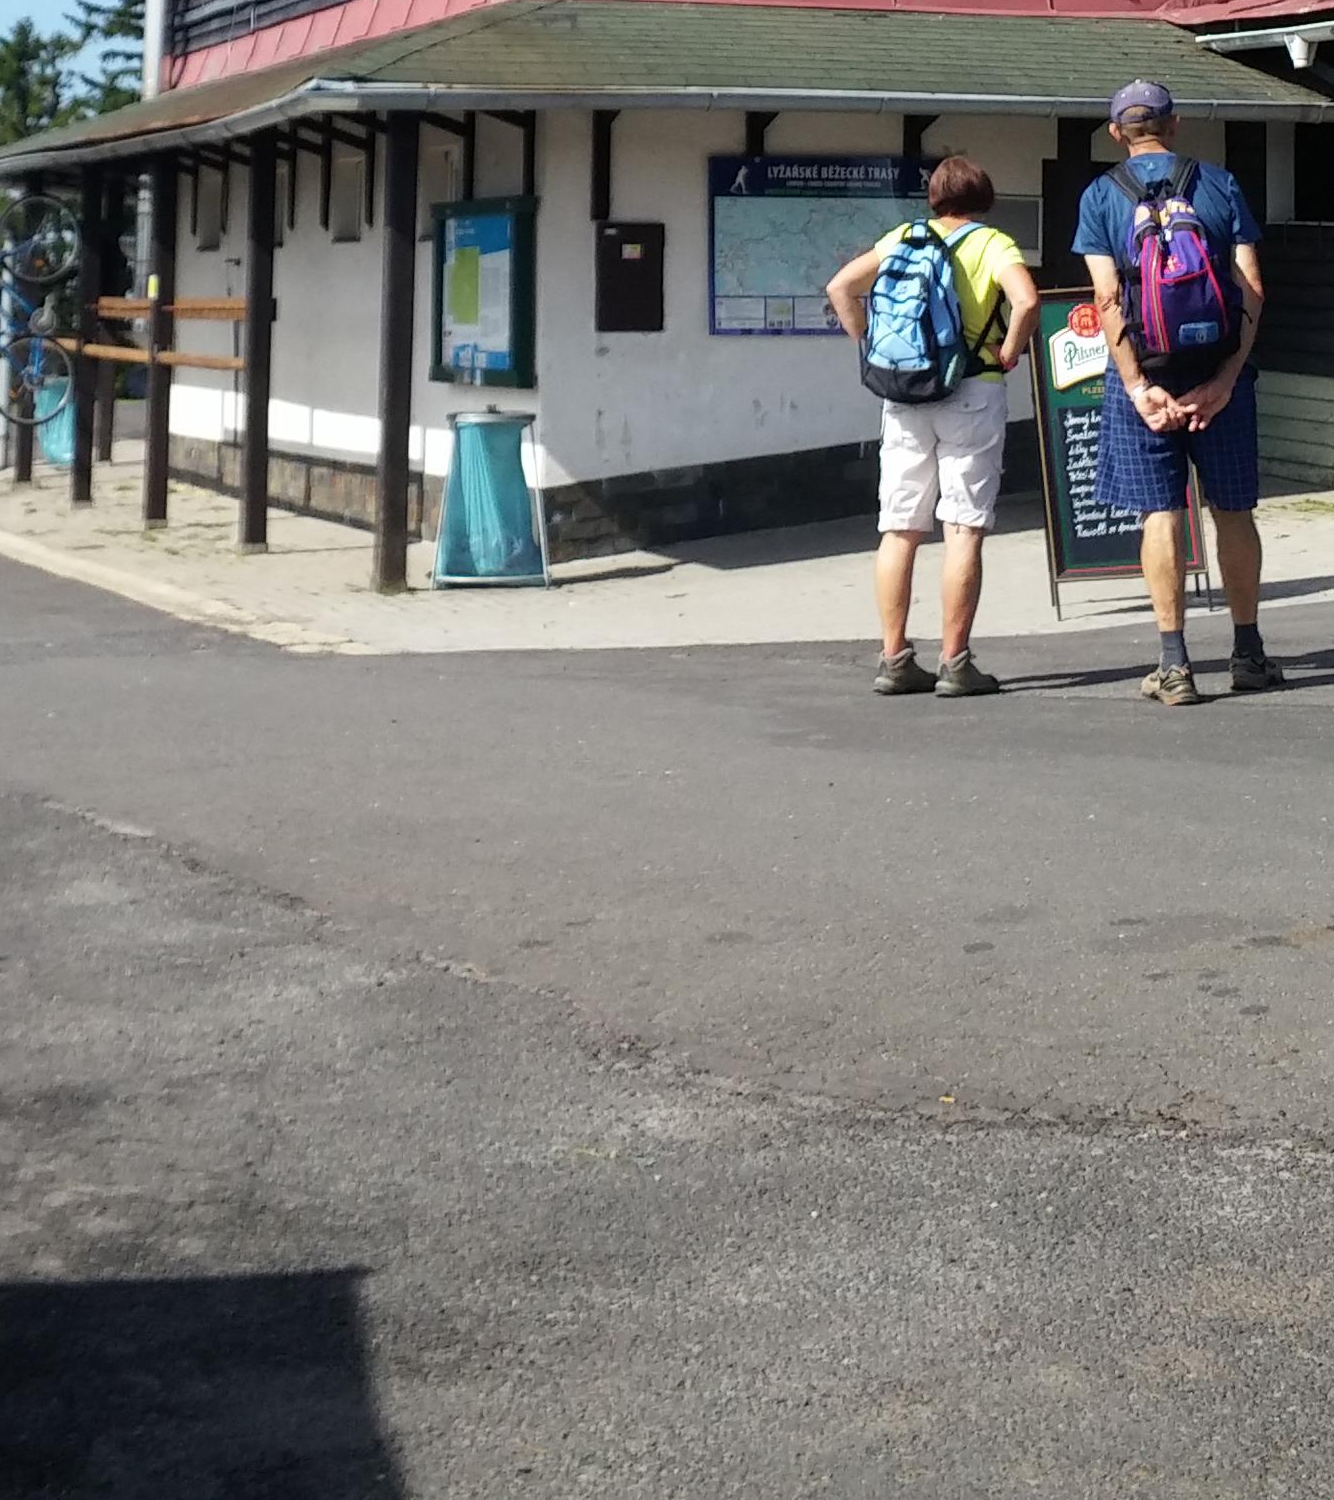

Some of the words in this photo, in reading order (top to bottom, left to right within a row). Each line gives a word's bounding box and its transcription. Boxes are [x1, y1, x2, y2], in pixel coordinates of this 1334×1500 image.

[767, 164, 819, 180] LYŽAŘSKÉ
[820, 164, 866, 180] BĚŽECKÉ
[867, 166, 900, 181] TRASY
[1063, 340, 1107, 370] Pilsner
